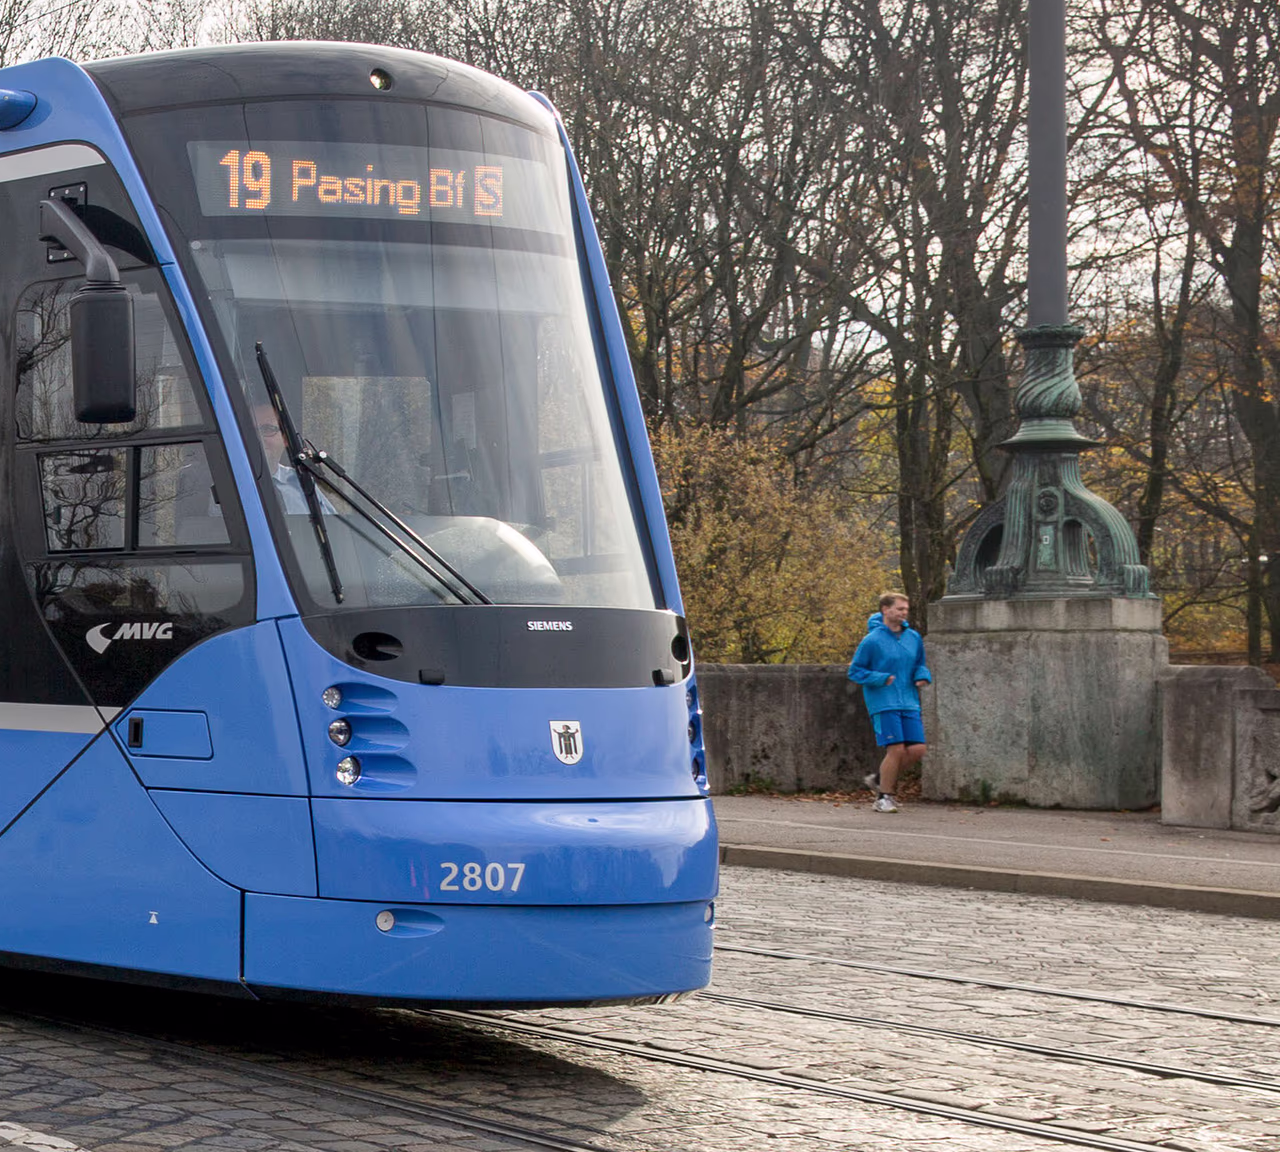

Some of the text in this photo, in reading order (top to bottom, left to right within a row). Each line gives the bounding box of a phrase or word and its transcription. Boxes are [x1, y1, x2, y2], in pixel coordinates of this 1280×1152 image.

[219, 149, 503, 216] 19 Pasing Bf S
[112, 622, 173, 639] MVG
[527, 621, 573, 631] SIEMENS
[440, 862, 526, 892] 2807
